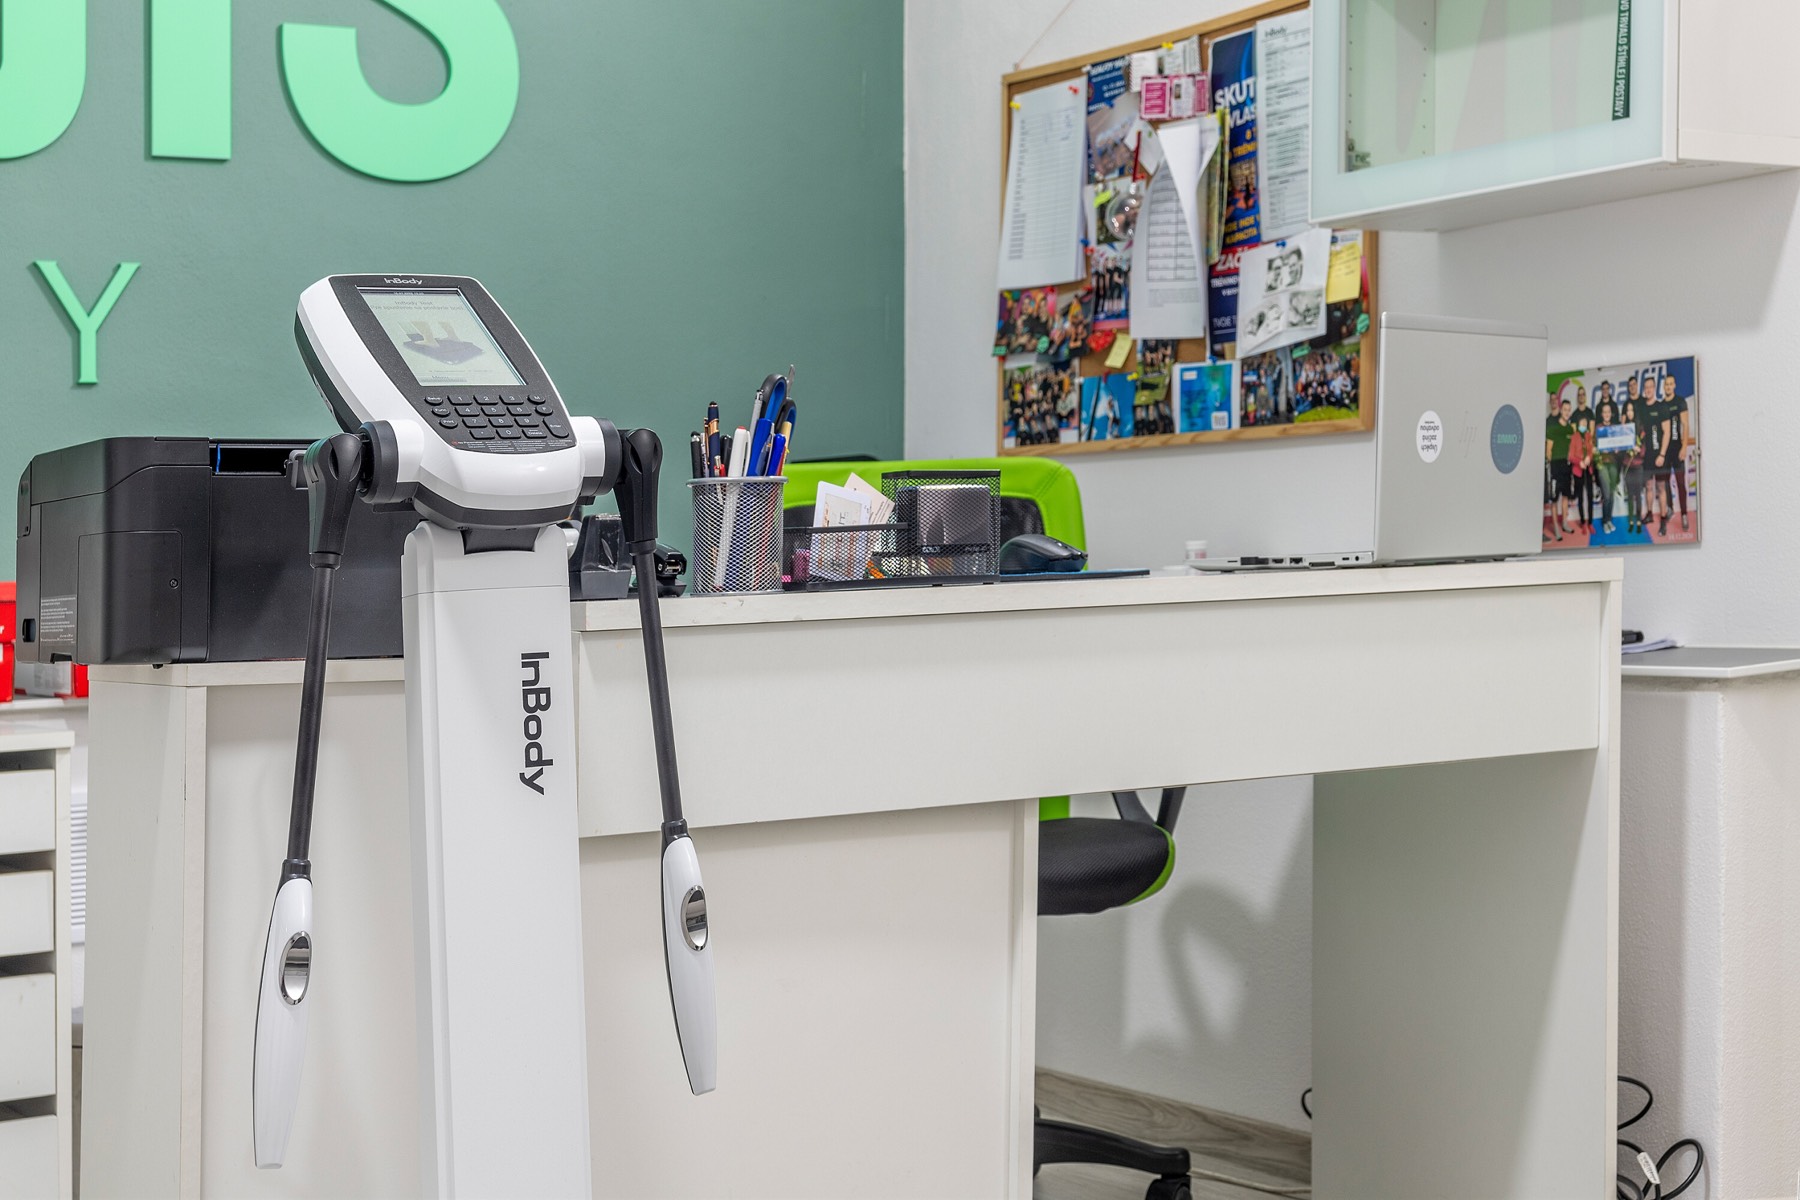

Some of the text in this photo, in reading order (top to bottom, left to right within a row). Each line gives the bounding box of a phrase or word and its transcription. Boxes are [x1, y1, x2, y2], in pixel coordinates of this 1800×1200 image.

[1613, 80, 1625, 118] POSTAVY
[383, 277, 423, 285] InBody
[33, 260, 141, 385] Y
[519, 651, 554, 796] InBody
